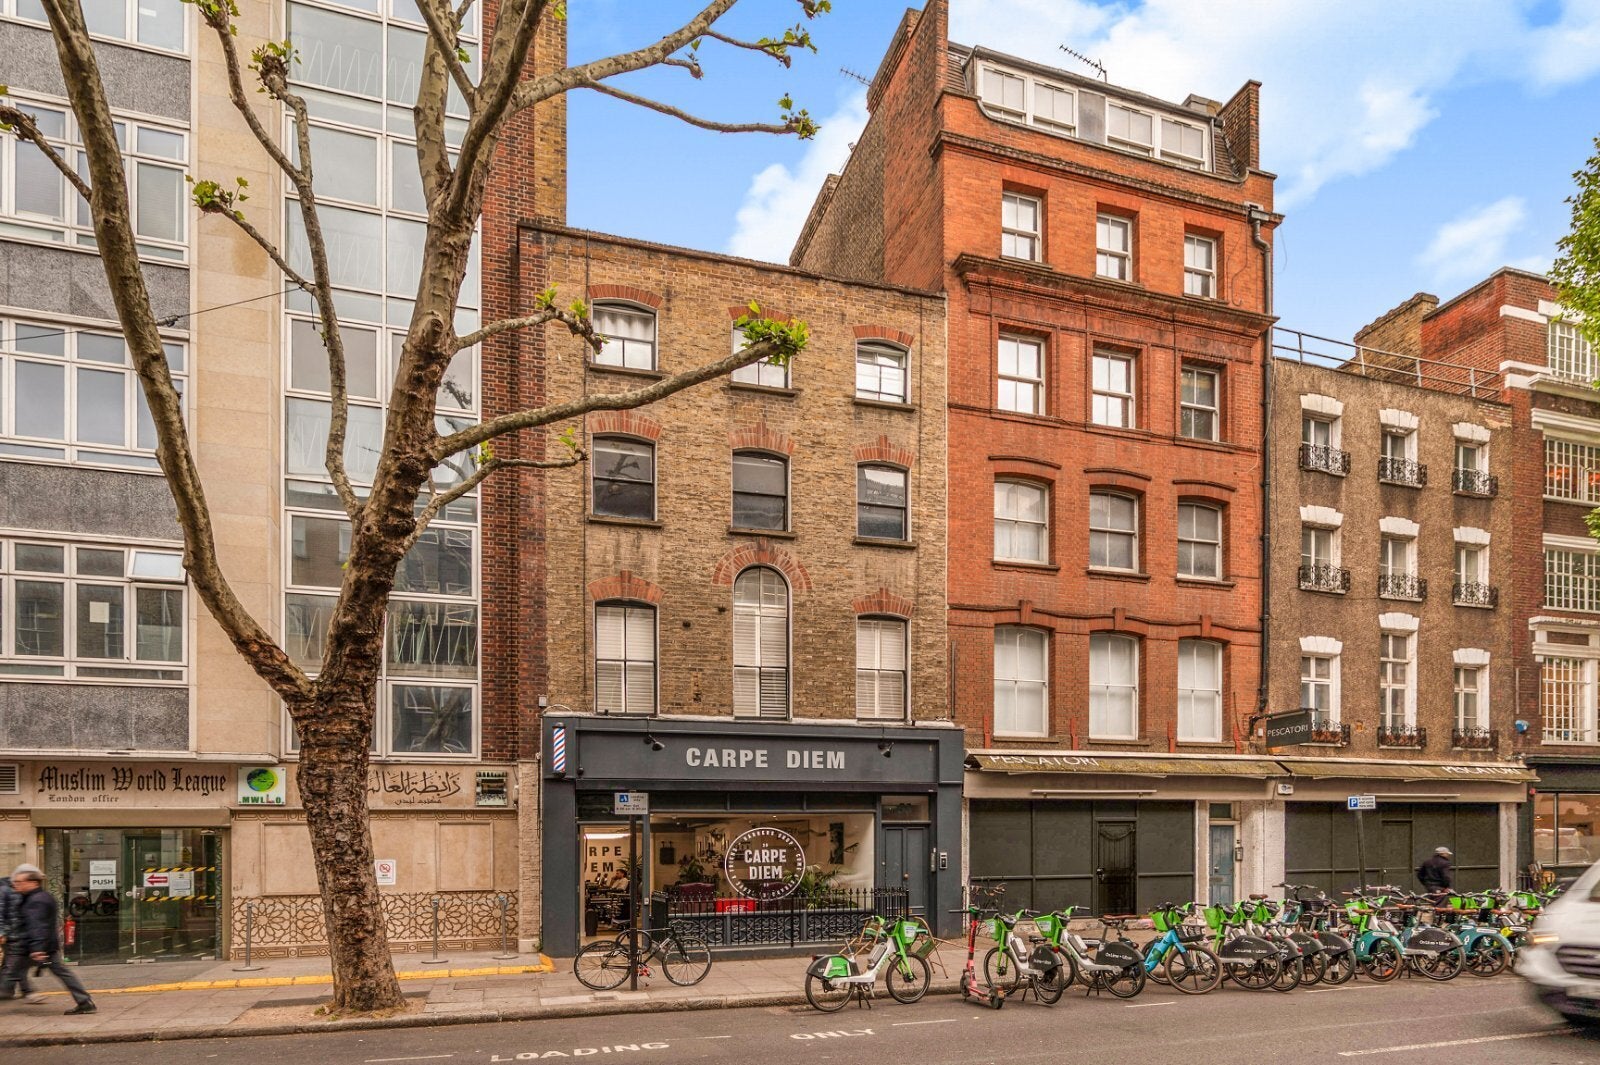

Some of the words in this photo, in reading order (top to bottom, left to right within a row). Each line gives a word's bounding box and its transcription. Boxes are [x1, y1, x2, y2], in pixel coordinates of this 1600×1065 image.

[1267, 724, 1308, 737] PESCATORI
[685, 747, 768, 768] CARPE
[786, 750, 845, 769] DIEM
[989, 755, 1099, 766] PESCATORI
[38, 766, 106, 794] Muslim
[112, 766, 166, 791] World
[171, 767, 227, 796] League
[48, 794, 85, 803] London
[92, 794, 120, 803] office
[744, 849, 787, 863] CARPE
[749, 865, 783, 880] DIEM
[790, 1028, 875, 1040] ONLY
[490, 1042, 670, 1062] LOADING
